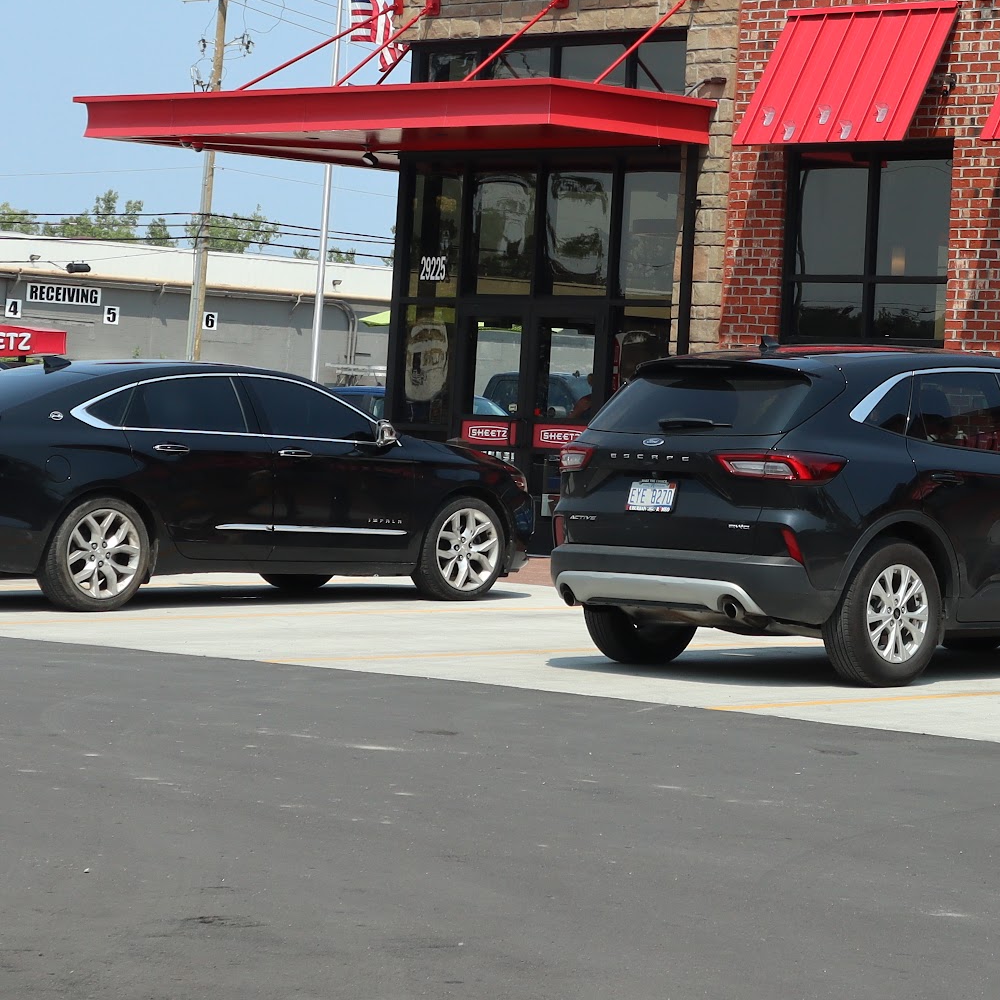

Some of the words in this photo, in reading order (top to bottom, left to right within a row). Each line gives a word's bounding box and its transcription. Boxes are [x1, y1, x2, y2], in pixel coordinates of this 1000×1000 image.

[420, 255, 447, 281] 29225
[30, 285, 98, 304] RECEIVING
[8, 301, 18, 315] 4
[107, 307, 117, 323] 5
[205, 313, 215, 328] 6
[471, 428, 508, 438] SHEETZ
[610, 453, 690, 462] ESCAPE
[630, 488, 647, 504] EYE
[650, 489, 673, 505] 8270
